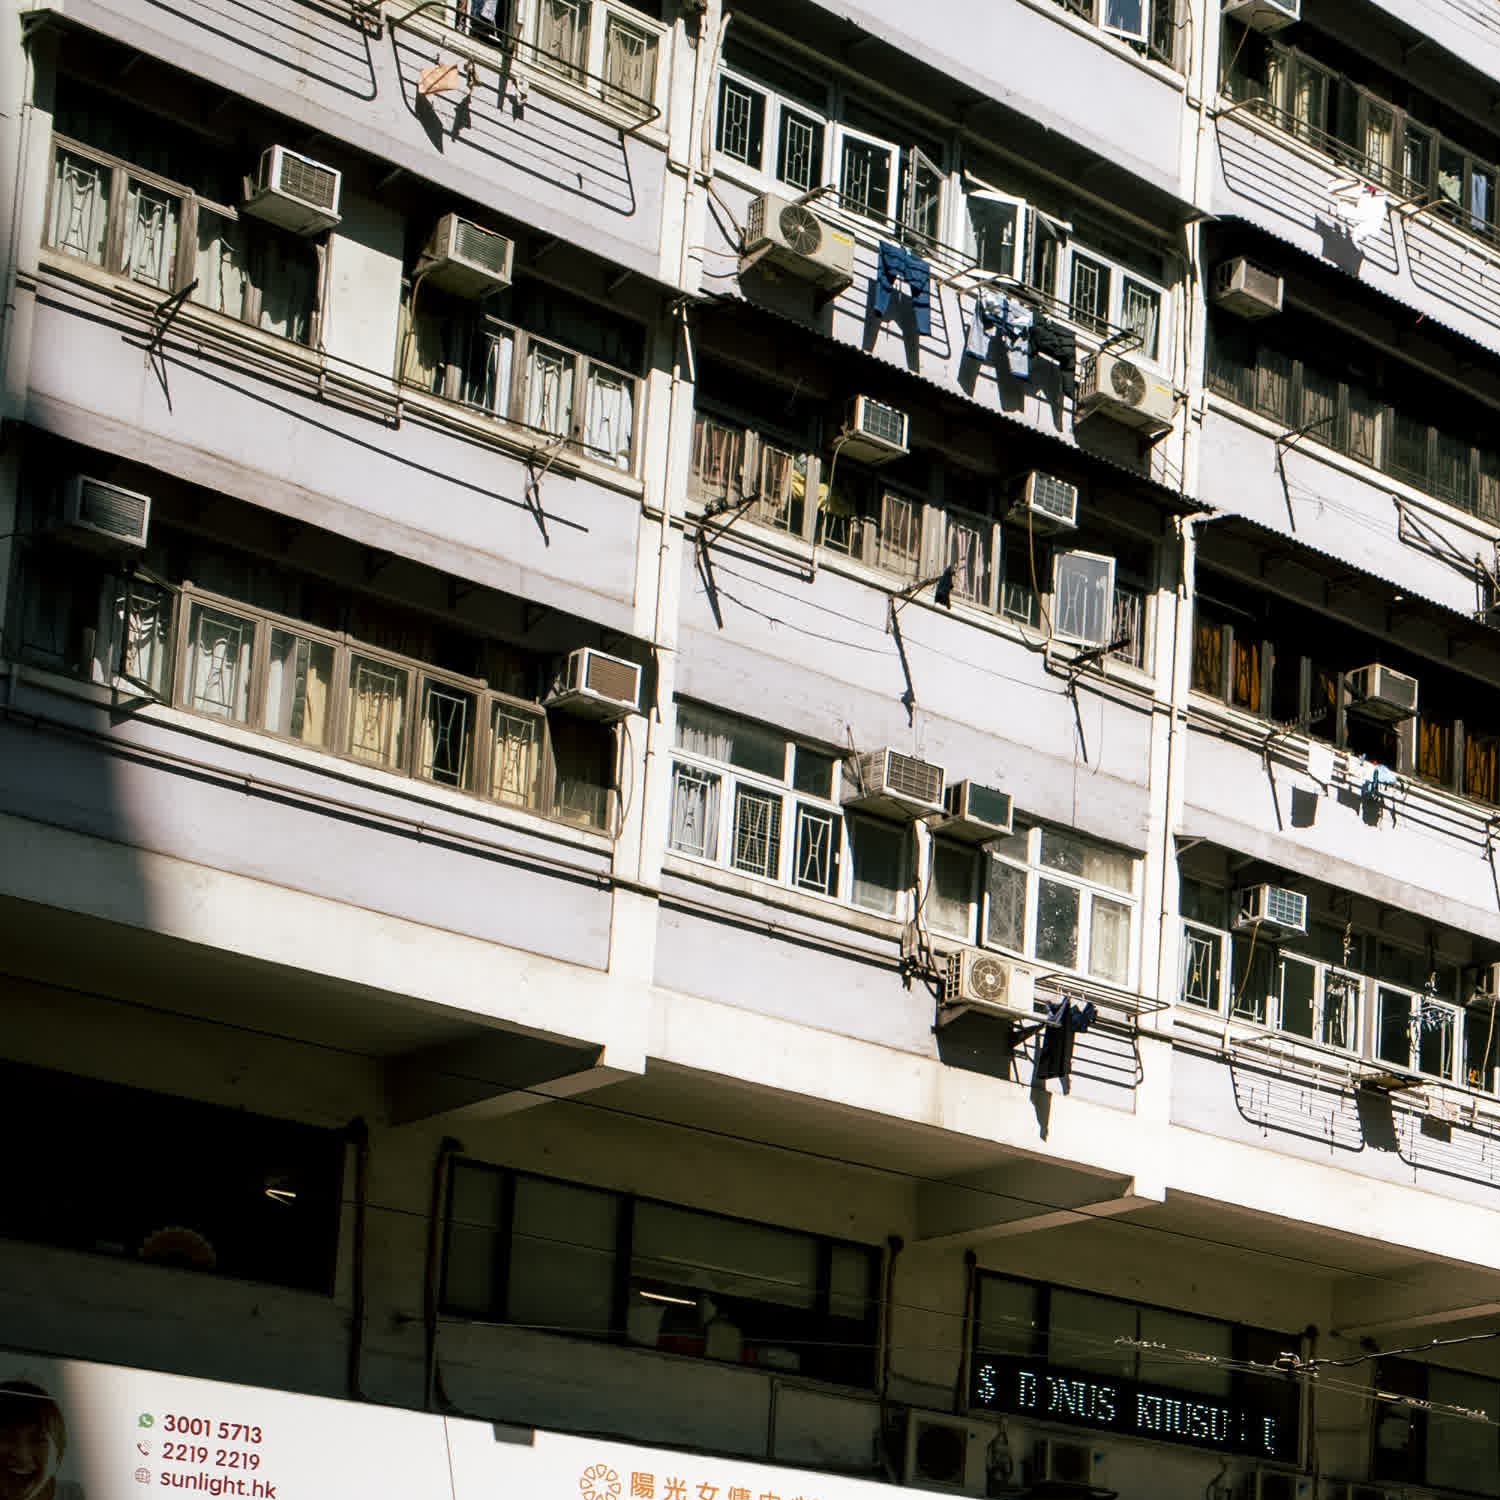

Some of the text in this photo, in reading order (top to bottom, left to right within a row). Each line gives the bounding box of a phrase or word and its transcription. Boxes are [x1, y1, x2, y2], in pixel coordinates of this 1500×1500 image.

[164, 1414, 262, 1444] 3001 5713
[162, 1442, 260, 1470] 2219 2219
[160, 1472, 277, 1500] sunlight.hk
